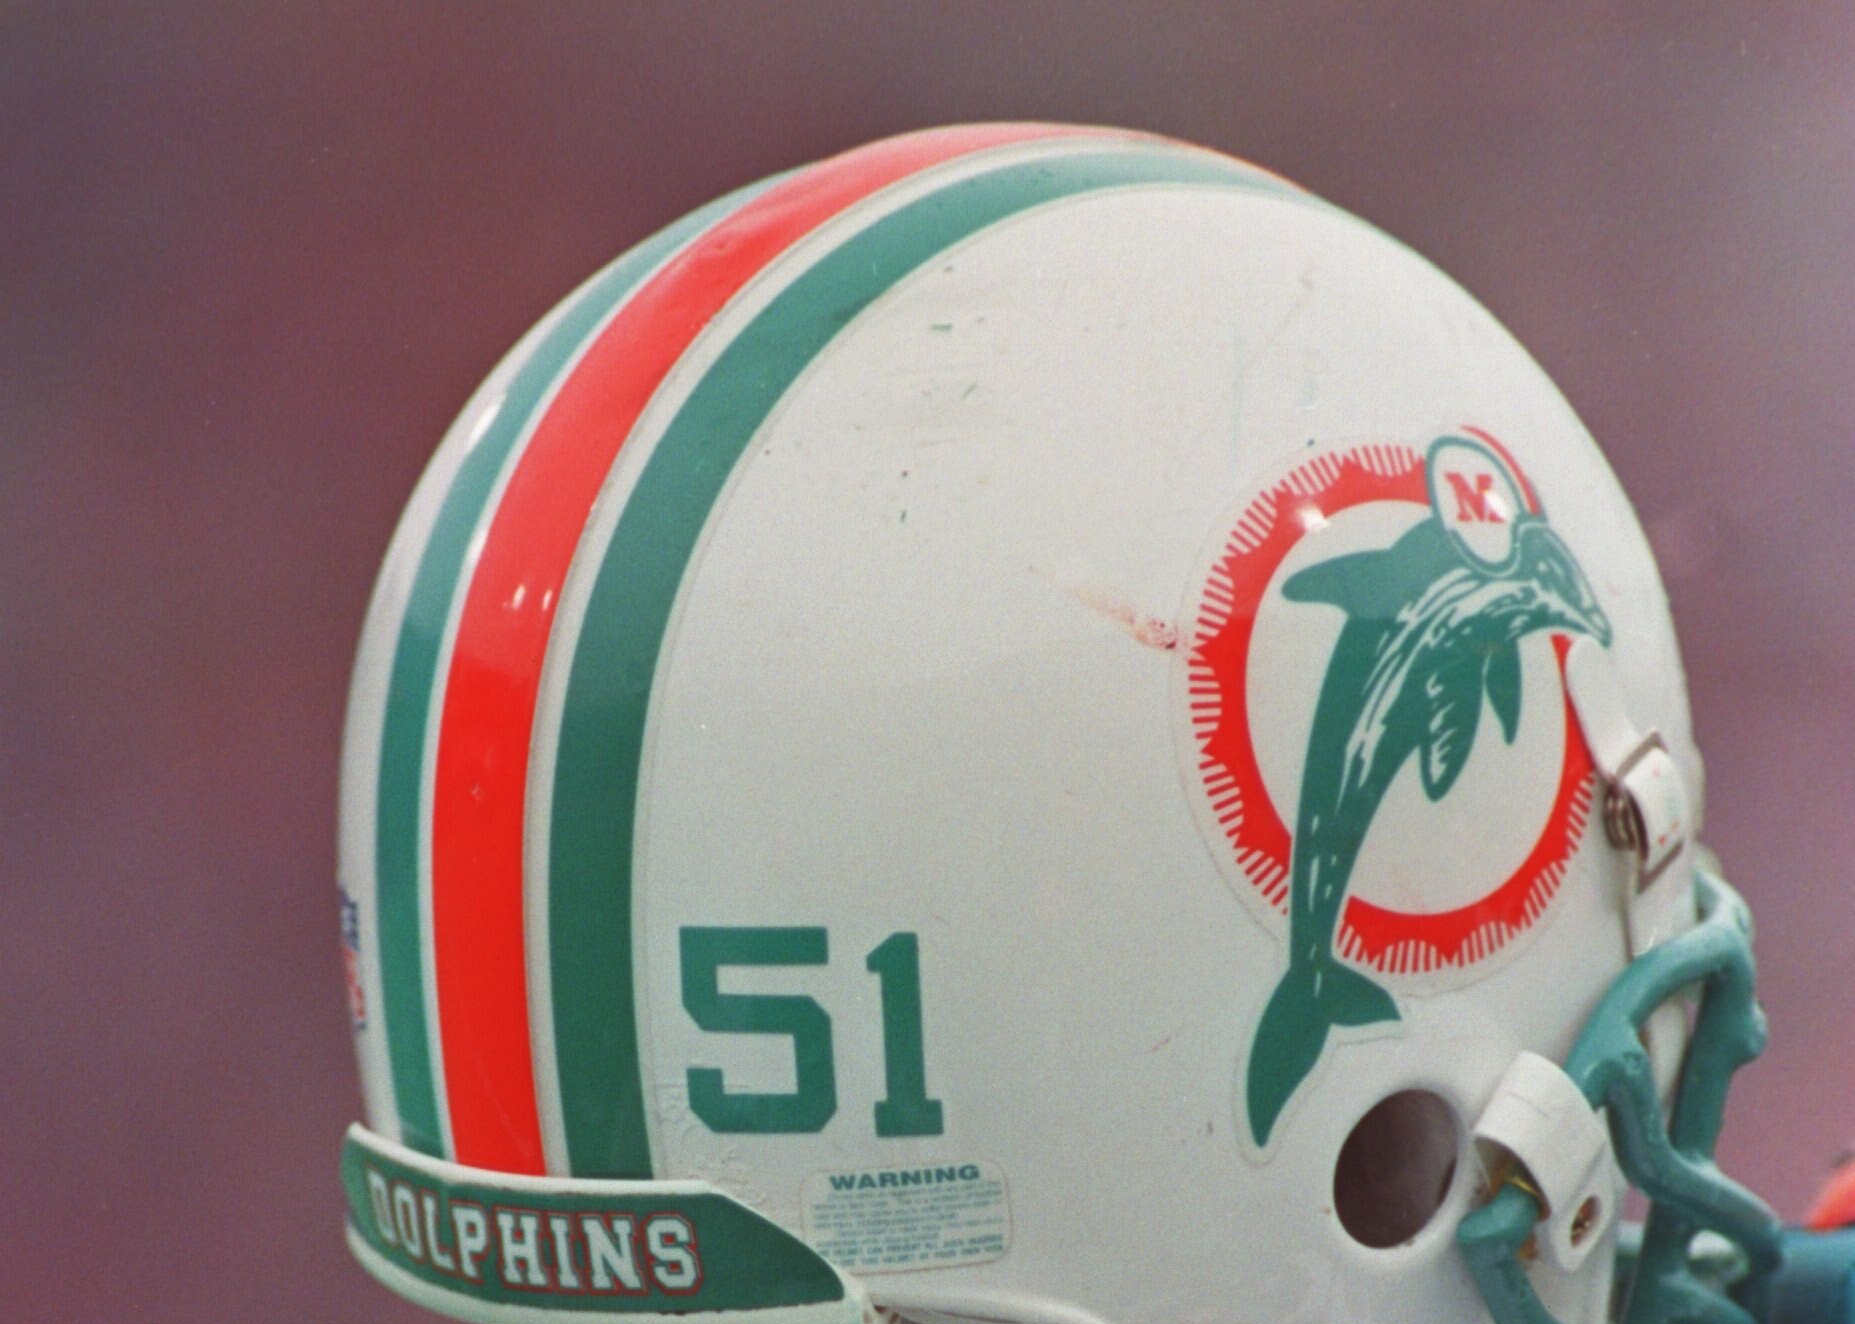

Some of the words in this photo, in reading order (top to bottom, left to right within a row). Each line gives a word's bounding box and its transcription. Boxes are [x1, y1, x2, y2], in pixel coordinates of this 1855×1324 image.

[679, 926, 944, 1138] 51
[367, 1165, 701, 1295] DOLPHINS
[829, 1164, 980, 1190] WARNING
